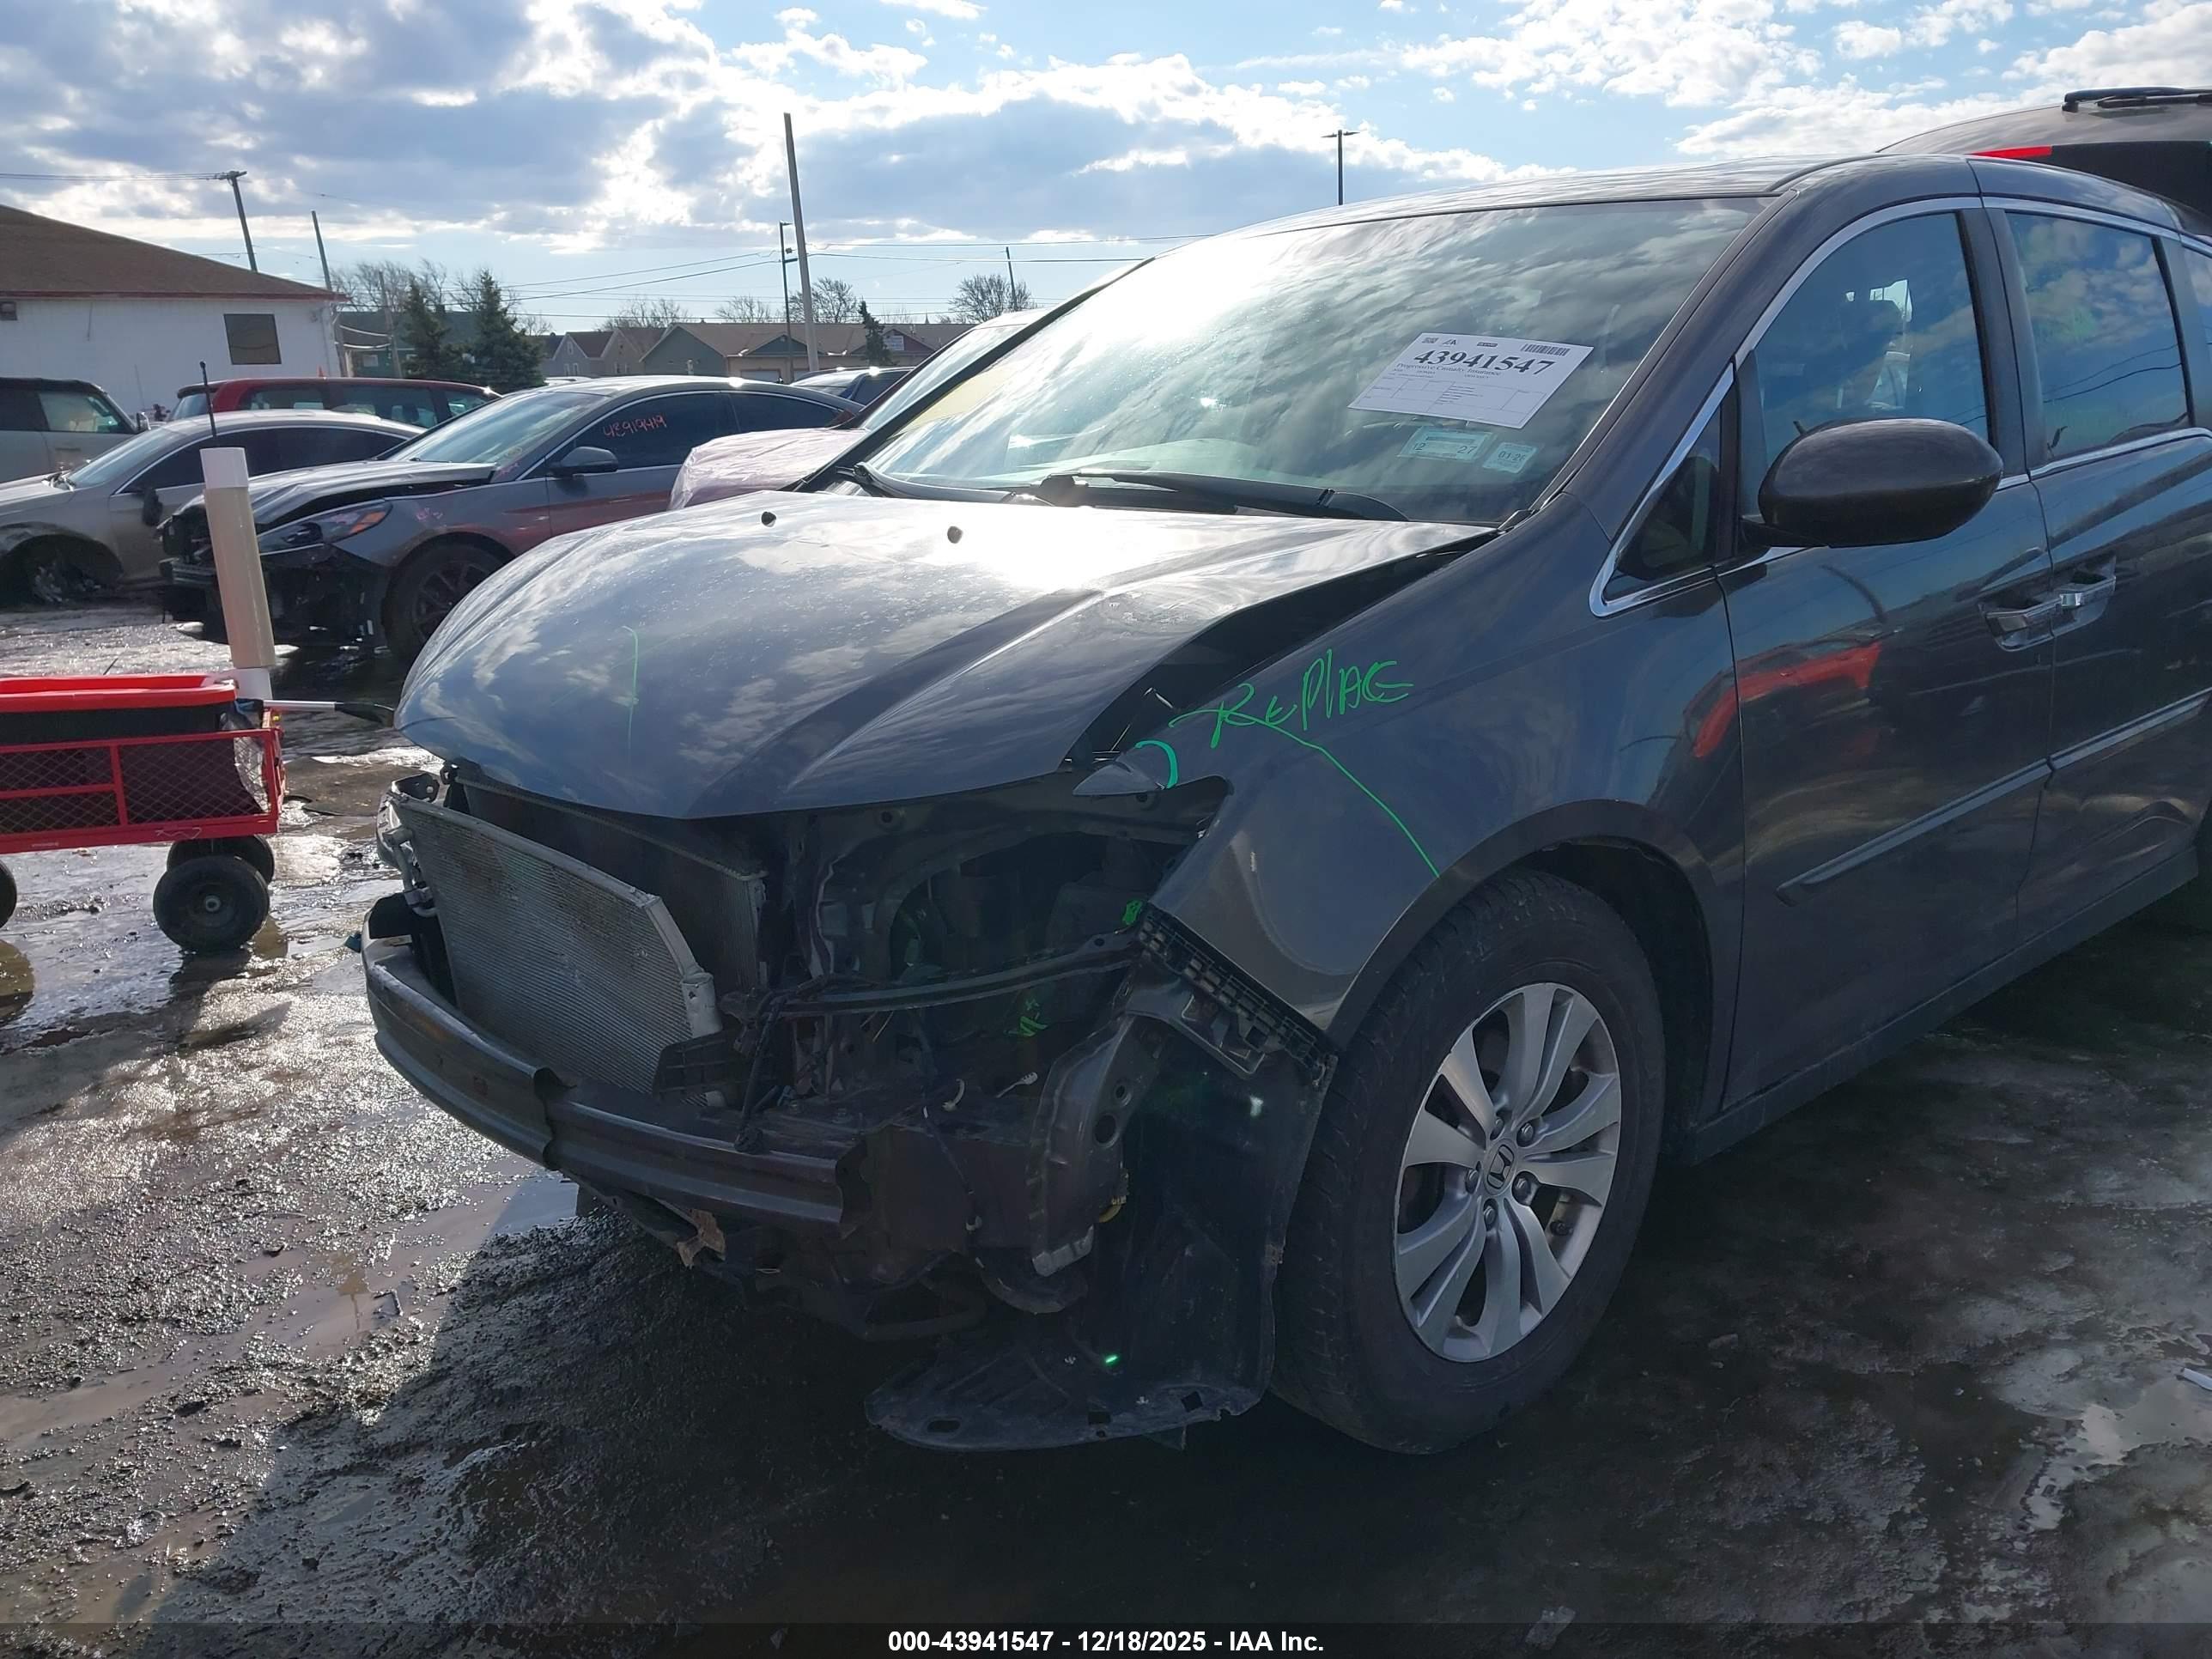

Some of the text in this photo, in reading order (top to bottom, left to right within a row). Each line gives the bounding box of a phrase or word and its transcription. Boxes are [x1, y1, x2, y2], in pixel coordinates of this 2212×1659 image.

[1414, 349, 1555, 375] 43941547
[1467, 368, 1502, 376] Insurance
[1457, 445, 1478, 454] 27
